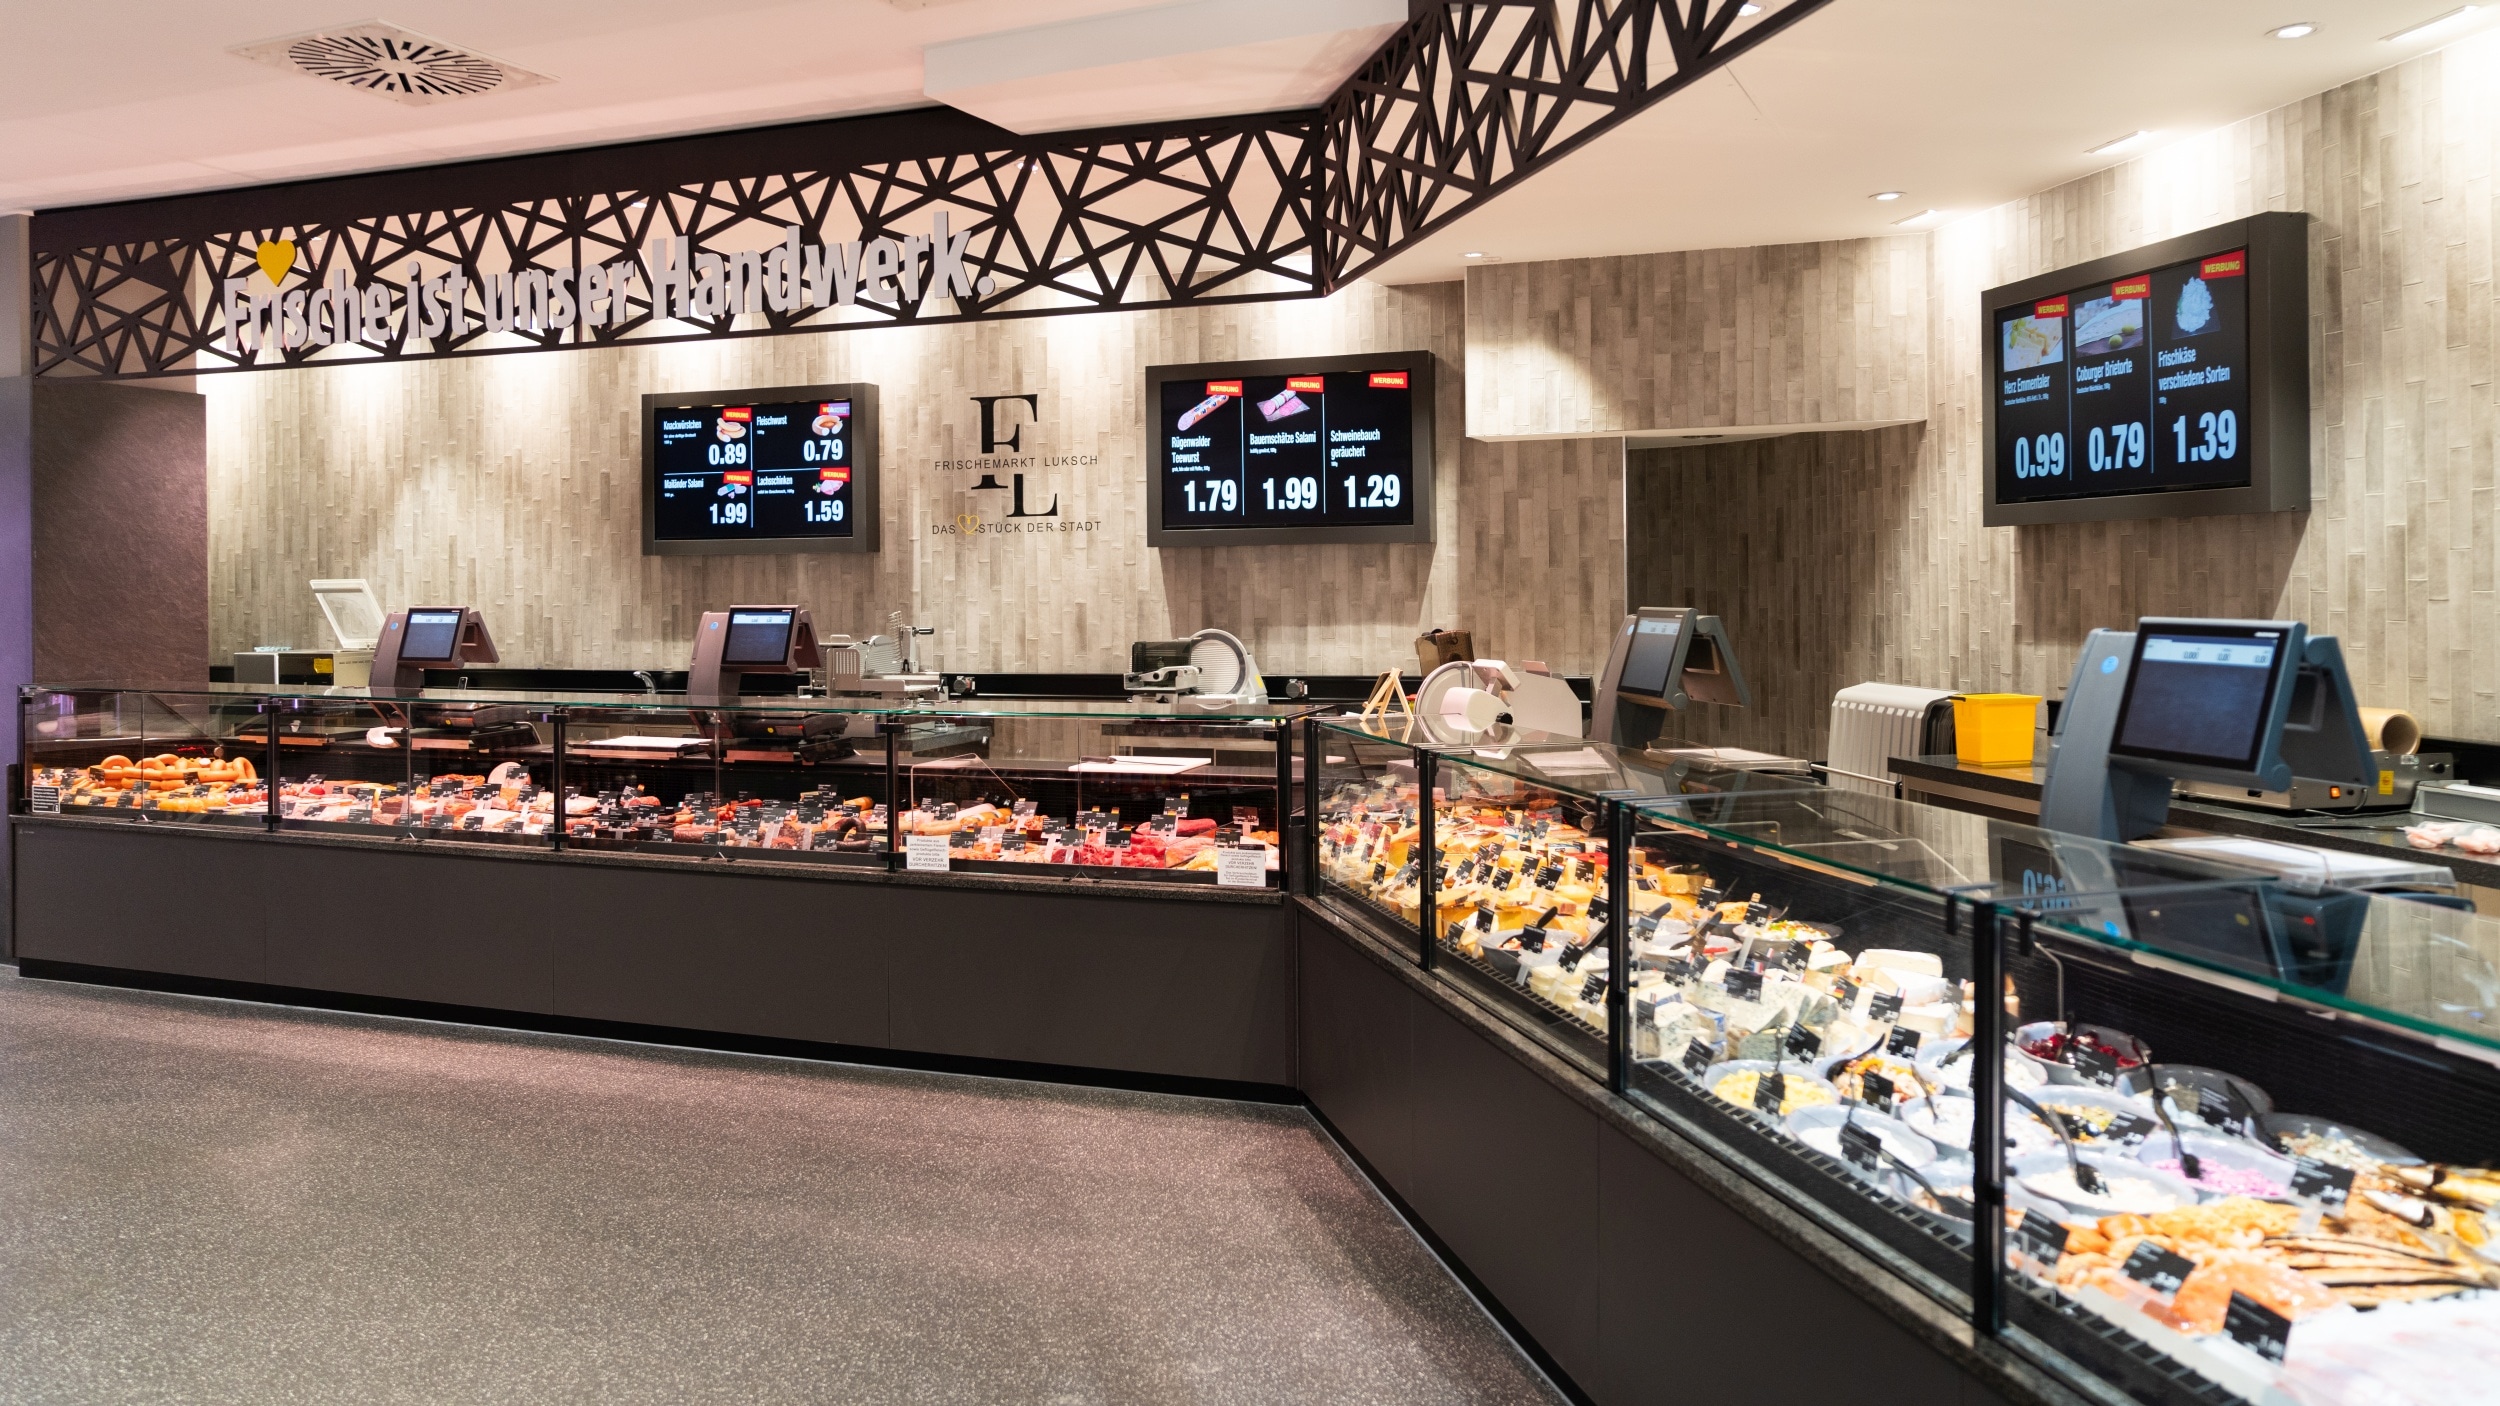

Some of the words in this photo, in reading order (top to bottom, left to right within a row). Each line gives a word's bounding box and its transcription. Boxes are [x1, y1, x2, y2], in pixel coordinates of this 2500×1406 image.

[2204, 260, 2241, 274] WERBUNG
[223, 268, 392, 350] Frische
[405, 261, 471, 339] ist
[486, 258, 636, 333] unser
[652, 211, 996, 321] Handwerk.
[2115, 282, 2147, 296] WERBUNG
[2037, 302, 2065, 315] WERBUNG
[2157, 347, 2197, 367] Frischkäse
[2075, 363, 2104, 383] Coburger
[2105, 359, 2133, 377] Brietorte
[1290, 380, 1320, 389] WERBUNG
[1373, 376, 1404, 385] WERBUNG
[2003, 379, 2016, 395] Herz
[2017, 374, 2051, 392] Emmentaler
[2157, 372, 2205, 391] verschiedene
[2205, 366, 2231, 383] Sorten
[1210, 385, 1239, 393] WERBUNG
[726, 411, 749, 419] WERBUNG
[756, 415, 788, 426] Fleischwurst
[663, 420, 702, 430] Knackwürstchen
[1249, 433, 1294, 445] Bauernschätze
[1295, 431, 1317, 443] Salami
[1330, 428, 1380, 442] Schweinebauch
[2172, 409, 2237, 463] 1.39
[1171, 435, 1211, 450] Rügenwalder
[2088, 420, 2145, 473] 0.79
[708, 442, 747, 466] 0.89
[803, 438, 843, 462] 0.79
[1171, 451, 1200, 463] Teewurst
[1330, 446, 1366, 460] geräuchert
[2014, 432, 2065, 479] 0.99
[934, 457, 1036, 471] FRISCHEMARKT
[1044, 455, 1098, 467] LUKSCH
[726, 474, 750, 483] WERBUNG
[757, 475, 793, 486] Lachsschinken
[823, 470, 848, 479] WERBUNG
[664, 478, 687, 489] Mailänder
[688, 478, 704, 488] Salami
[1006, 473, 1058, 518] L
[1184, 478, 1237, 512] 1.79
[1262, 476, 1318, 511] 1.99
[1343, 474, 1401, 508] 1.29
[709, 502, 747, 525] 1.99
[805, 499, 844, 522] 1.59
[932, 524, 956, 535] DAS
[1027, 522, 1054, 533] DER
[1059, 521, 1102, 532] STADT
